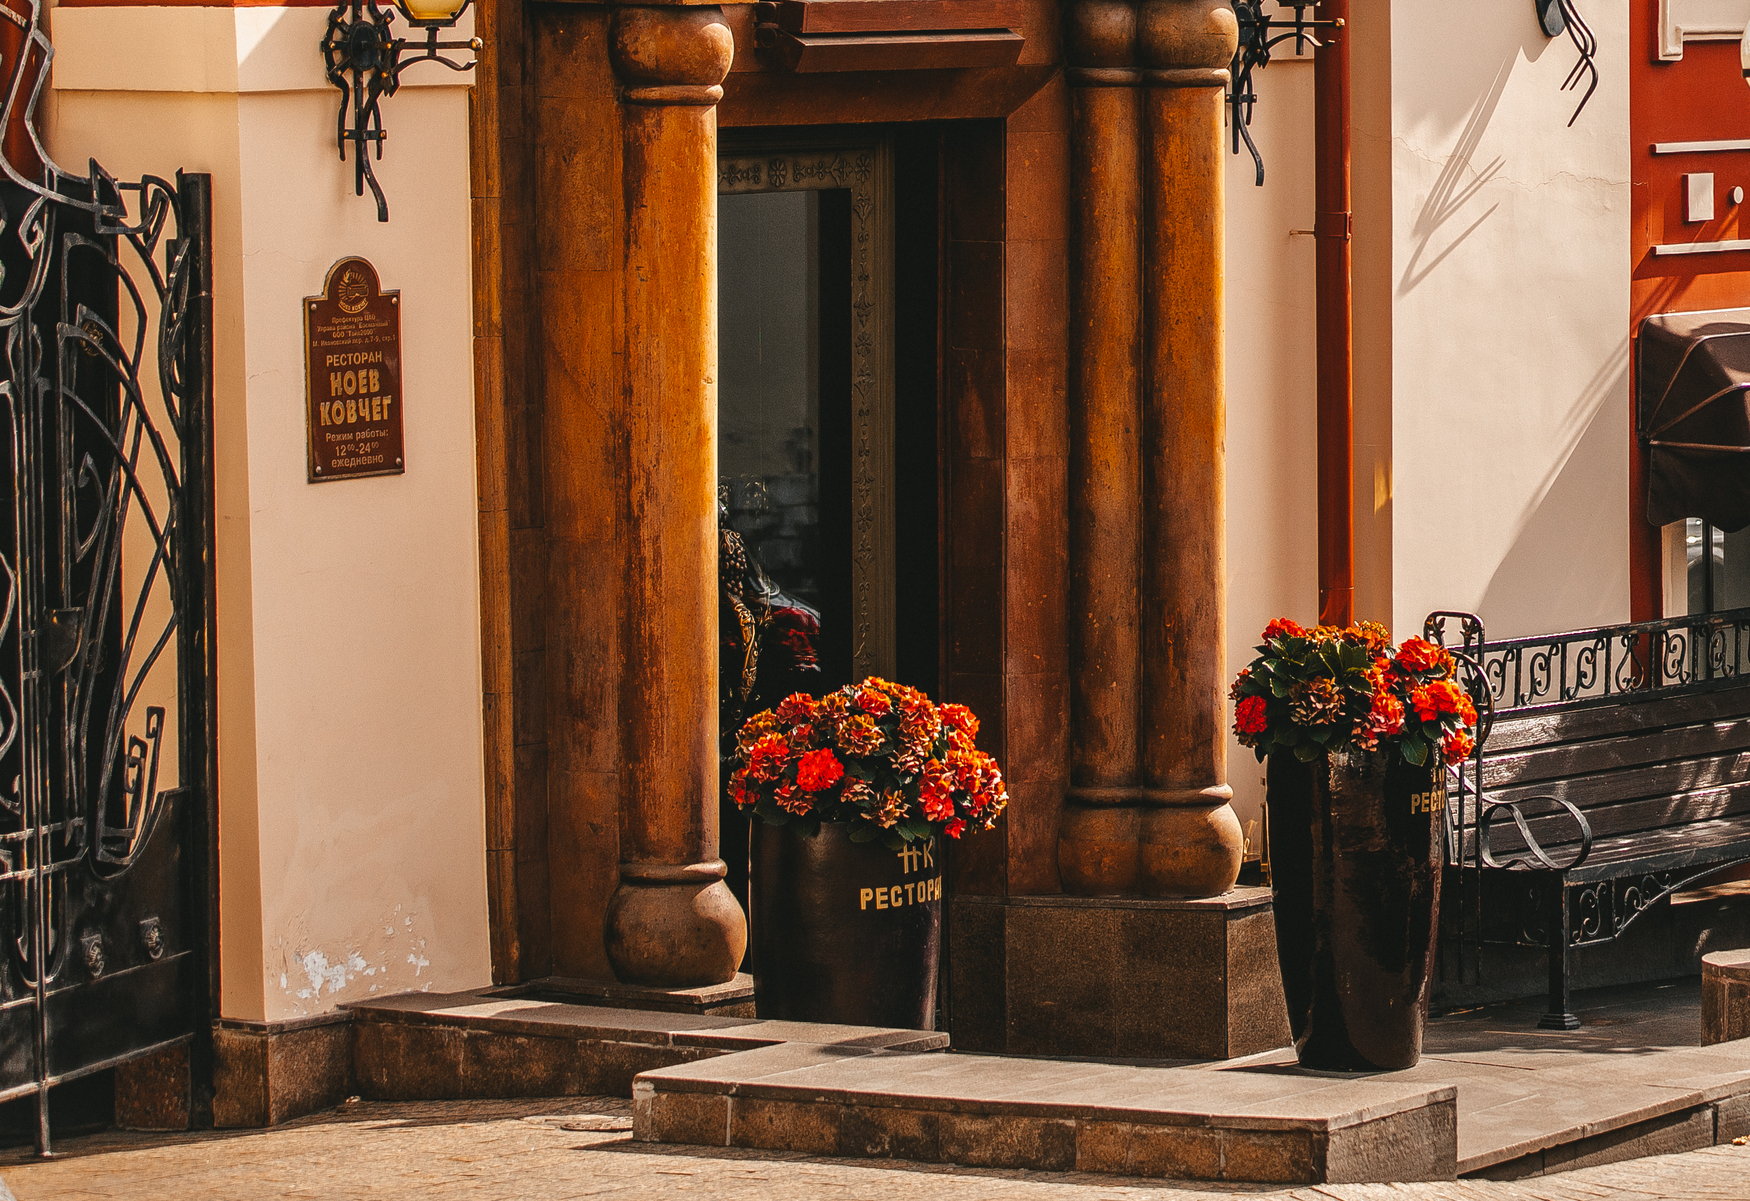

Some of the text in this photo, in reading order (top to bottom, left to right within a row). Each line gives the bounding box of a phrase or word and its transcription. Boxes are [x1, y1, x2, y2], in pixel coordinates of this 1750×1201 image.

[326, 350, 382, 367] РЕСТОРАН
[330, 368, 380, 396] НОЕВ
[320, 395, 392, 426] КОВЧЕГ
[326, 428, 389, 442] Режим работы:
[331, 454, 384, 468] ежедневно
